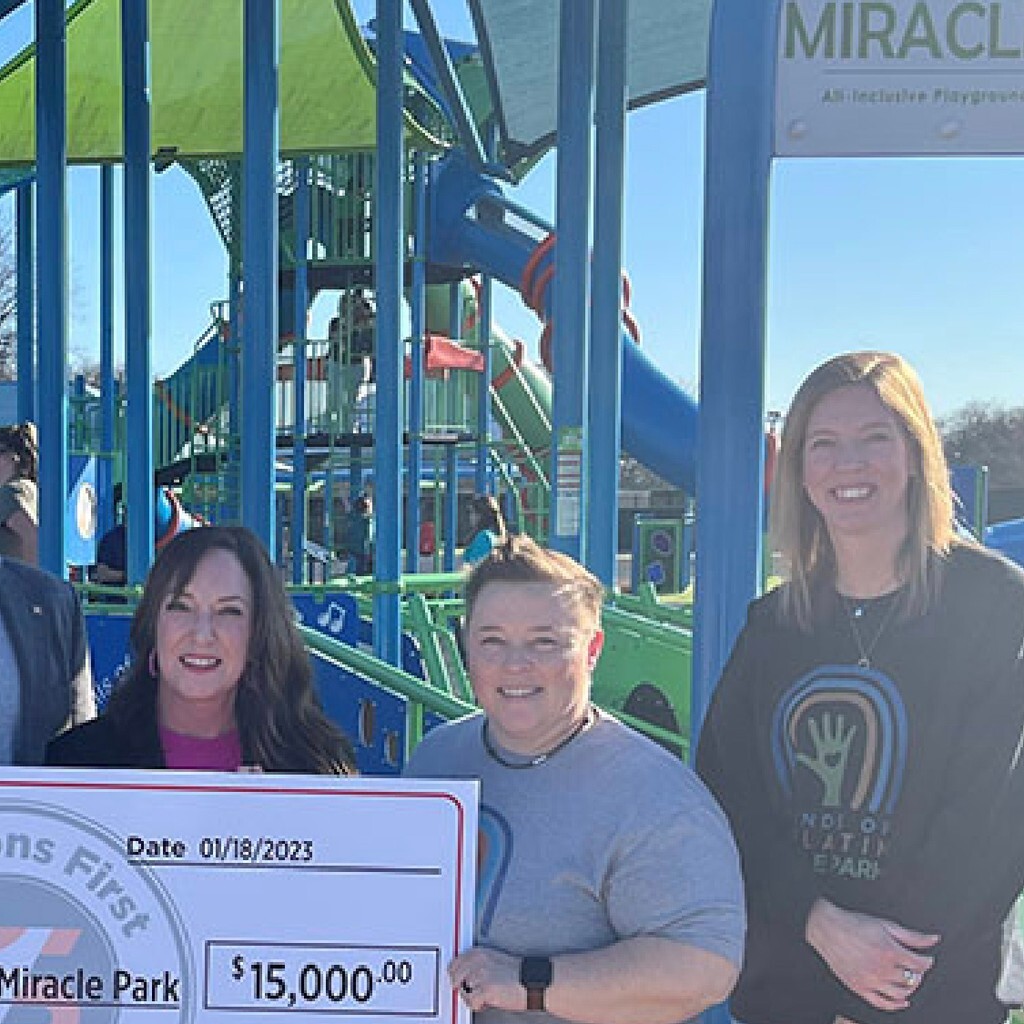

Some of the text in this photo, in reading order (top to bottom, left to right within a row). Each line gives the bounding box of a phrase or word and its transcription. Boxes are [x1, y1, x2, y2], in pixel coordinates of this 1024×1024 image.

[783, 2, 1024, 59] MIRACL
[127, 836, 313, 861] Date 01/18/2023
[64, 845, 150, 938] First
[113, 969, 181, 1002] Park
[232, 954, 413, 1007] $15,000.00
